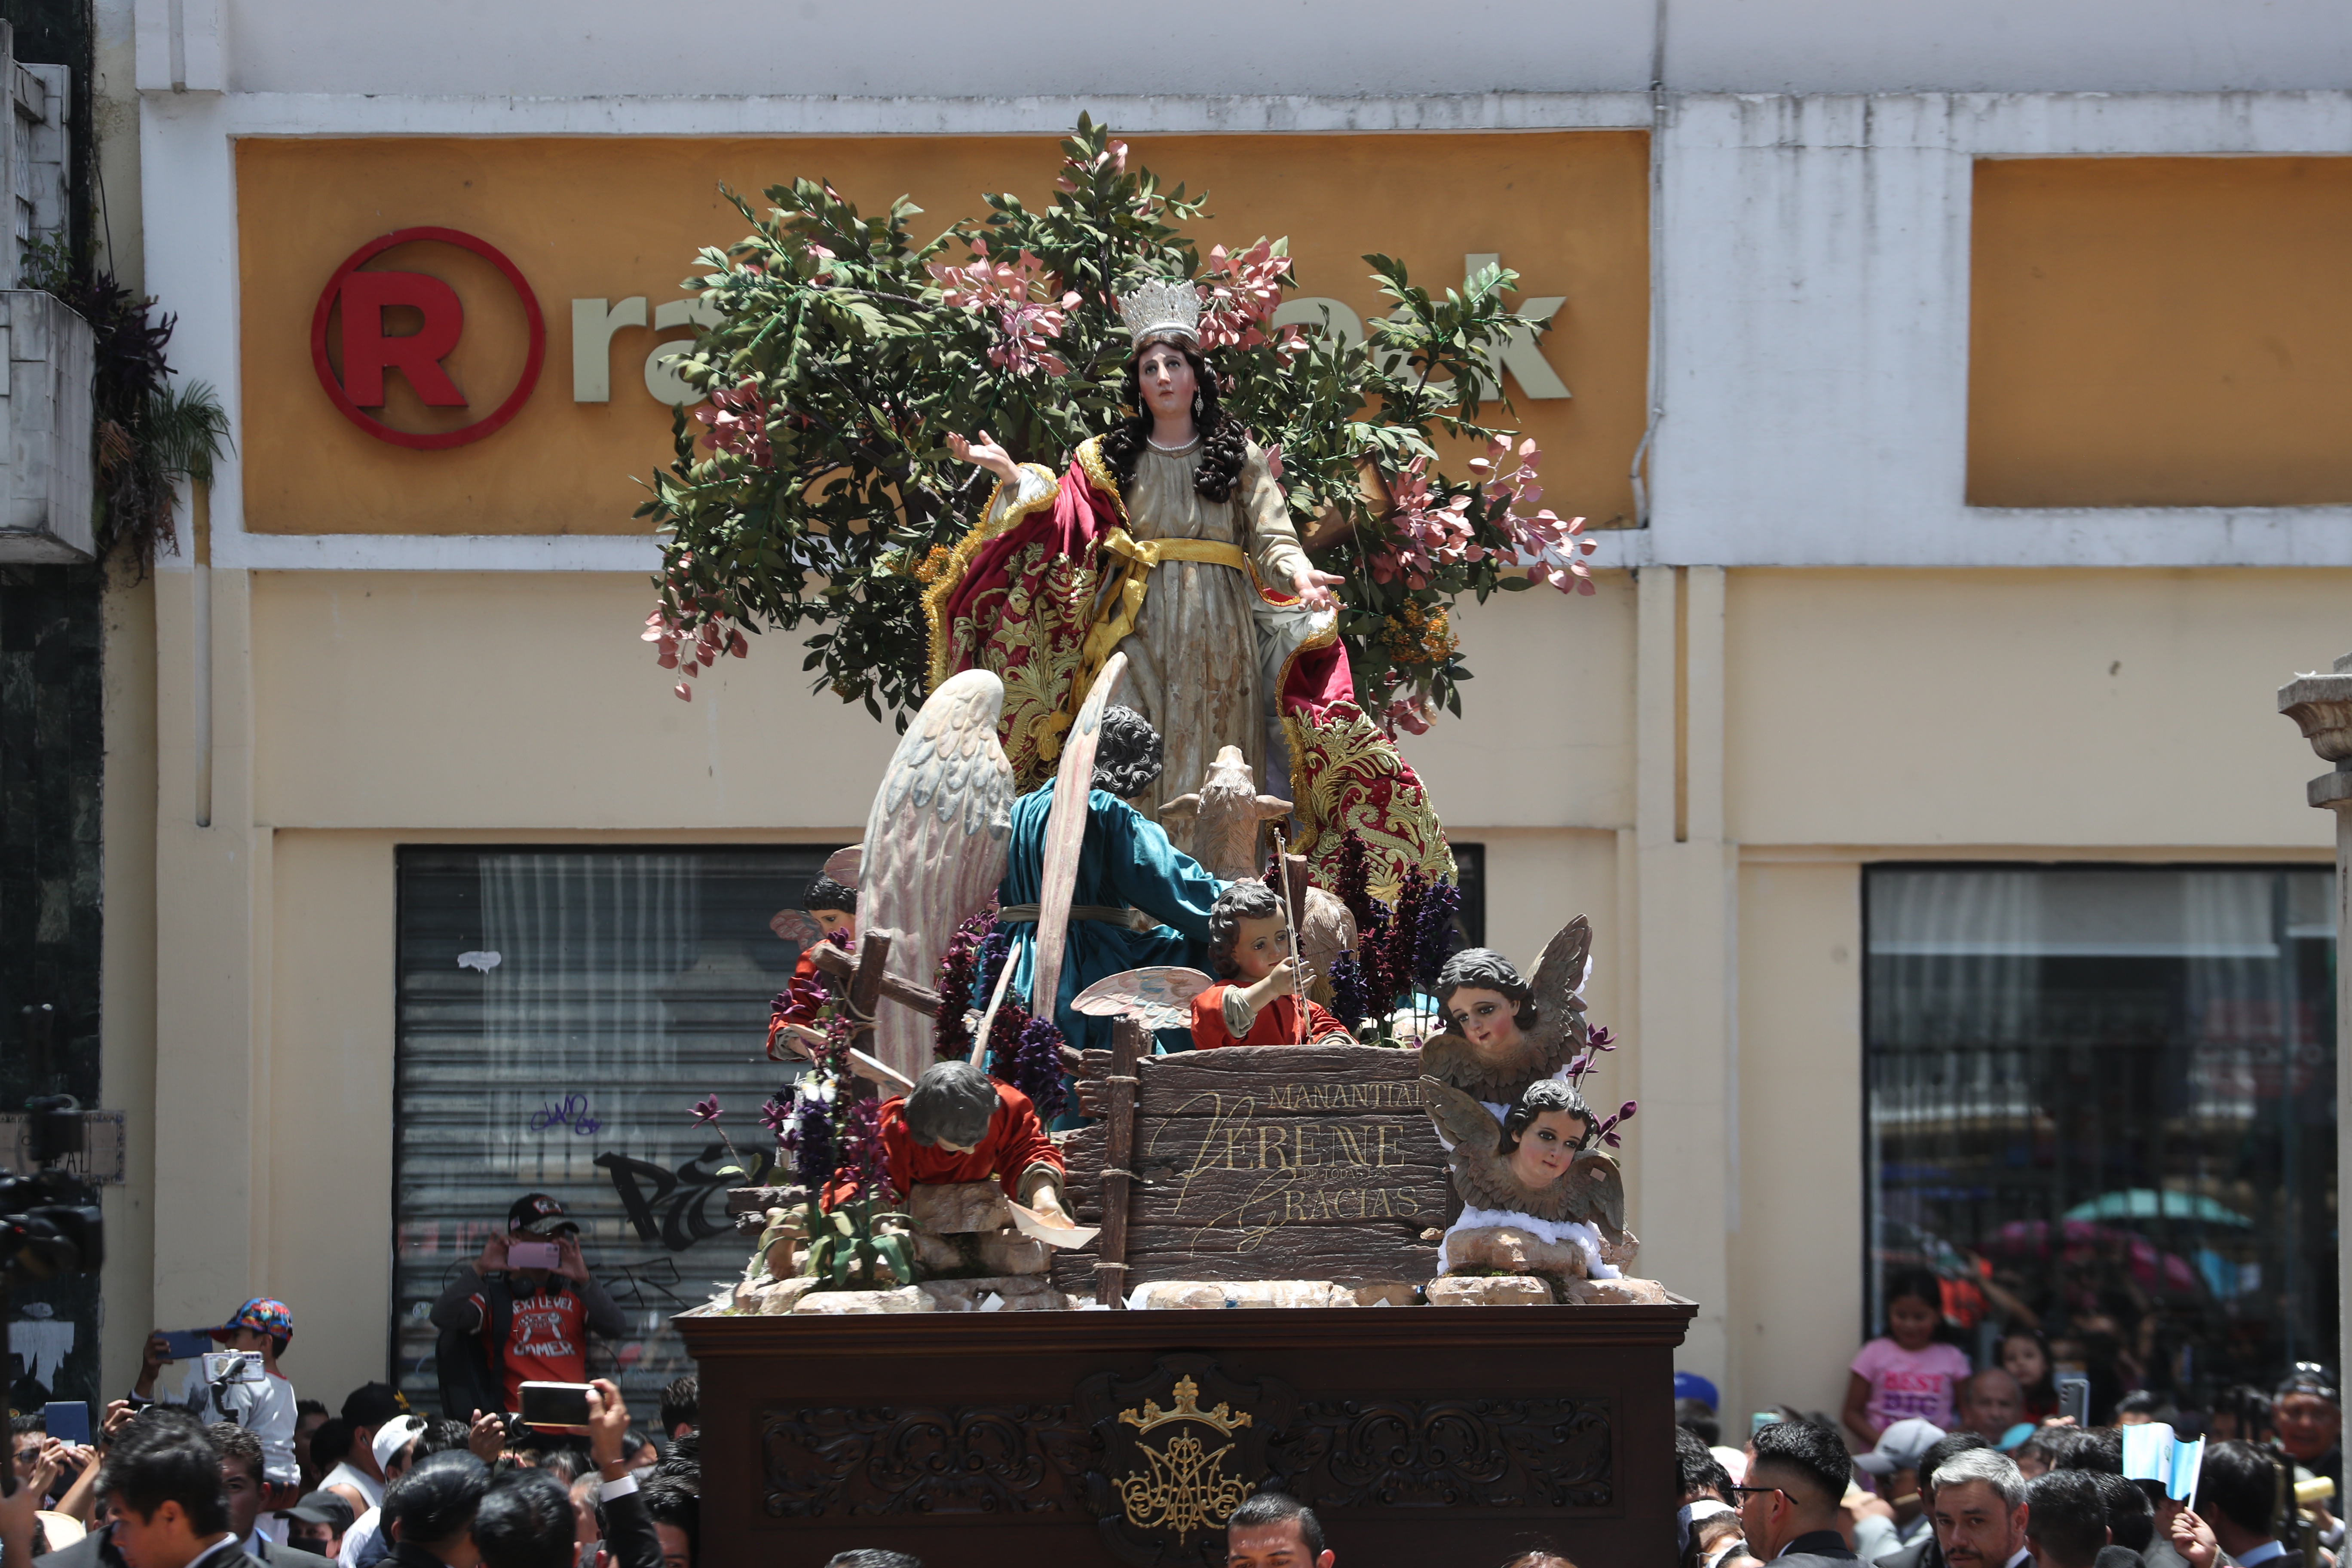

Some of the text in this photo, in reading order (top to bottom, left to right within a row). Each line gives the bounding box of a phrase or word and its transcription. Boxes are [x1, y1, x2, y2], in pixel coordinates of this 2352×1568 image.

[1303, 1168, 1319, 1181] DE
[1323, 1168, 1363, 1179] TODAS
[538, 1294, 573, 1312] LEVEL
[513, 1340, 576, 1357] GAMER
[1884, 1372, 1942, 1393] BEST
